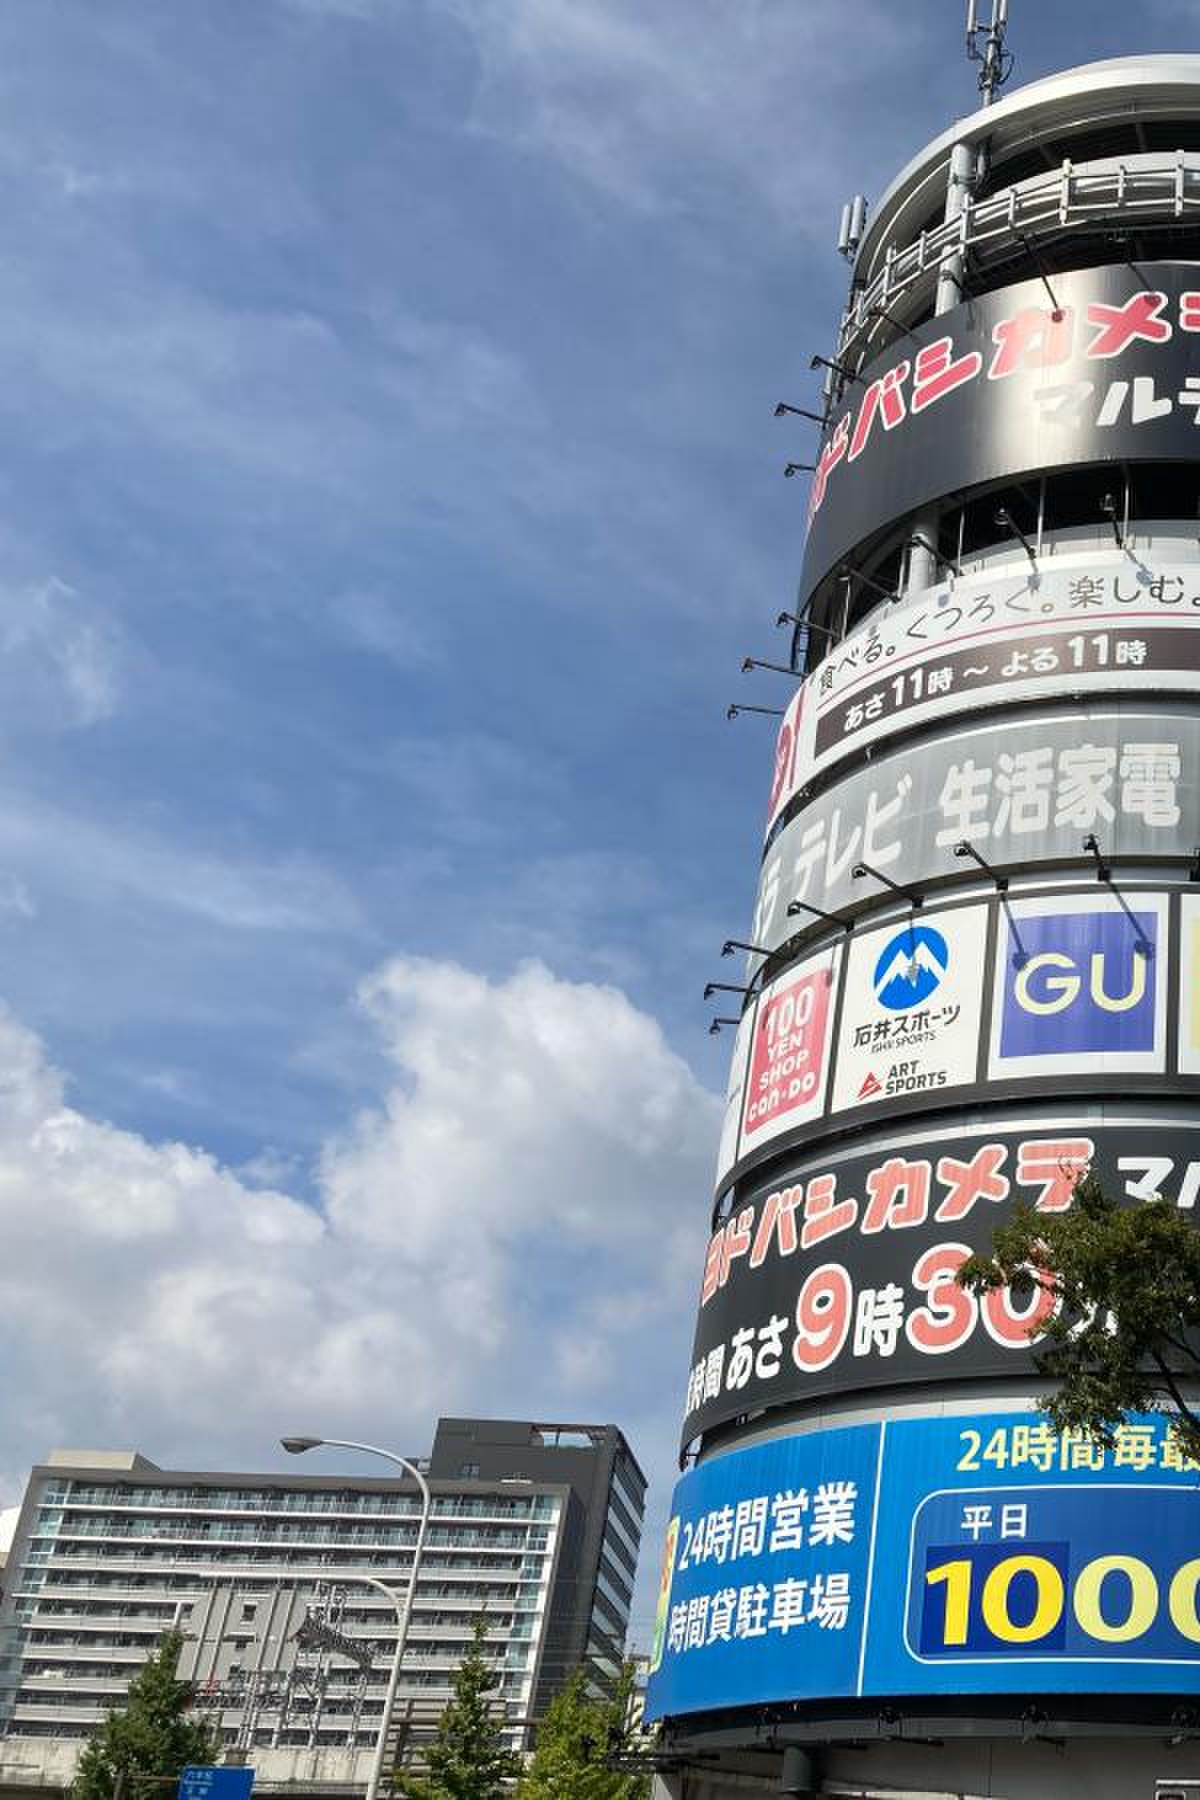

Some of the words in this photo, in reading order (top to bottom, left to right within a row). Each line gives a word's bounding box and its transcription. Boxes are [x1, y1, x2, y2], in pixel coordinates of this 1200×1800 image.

[792, 772, 914, 904] テレビ
[935, 742, 1182, 848] 生活家電
[1013, 952, 1147, 1016] GU
[768, 985, 815, 1047] 100
[853, 1004, 961, 1048] 石井スポーツ
[767, 1028, 803, 1062] YEN
[760, 1048, 809, 1090] SHOP
[885, 1070, 948, 1096] SPORTS
[887, 1059, 920, 1080] ART
[678, 1481, 858, 1571] 24時間営業
[959, 1502, 1028, 1540] 平日
[667, 1573, 851, 1653] 時間貸駐車場
